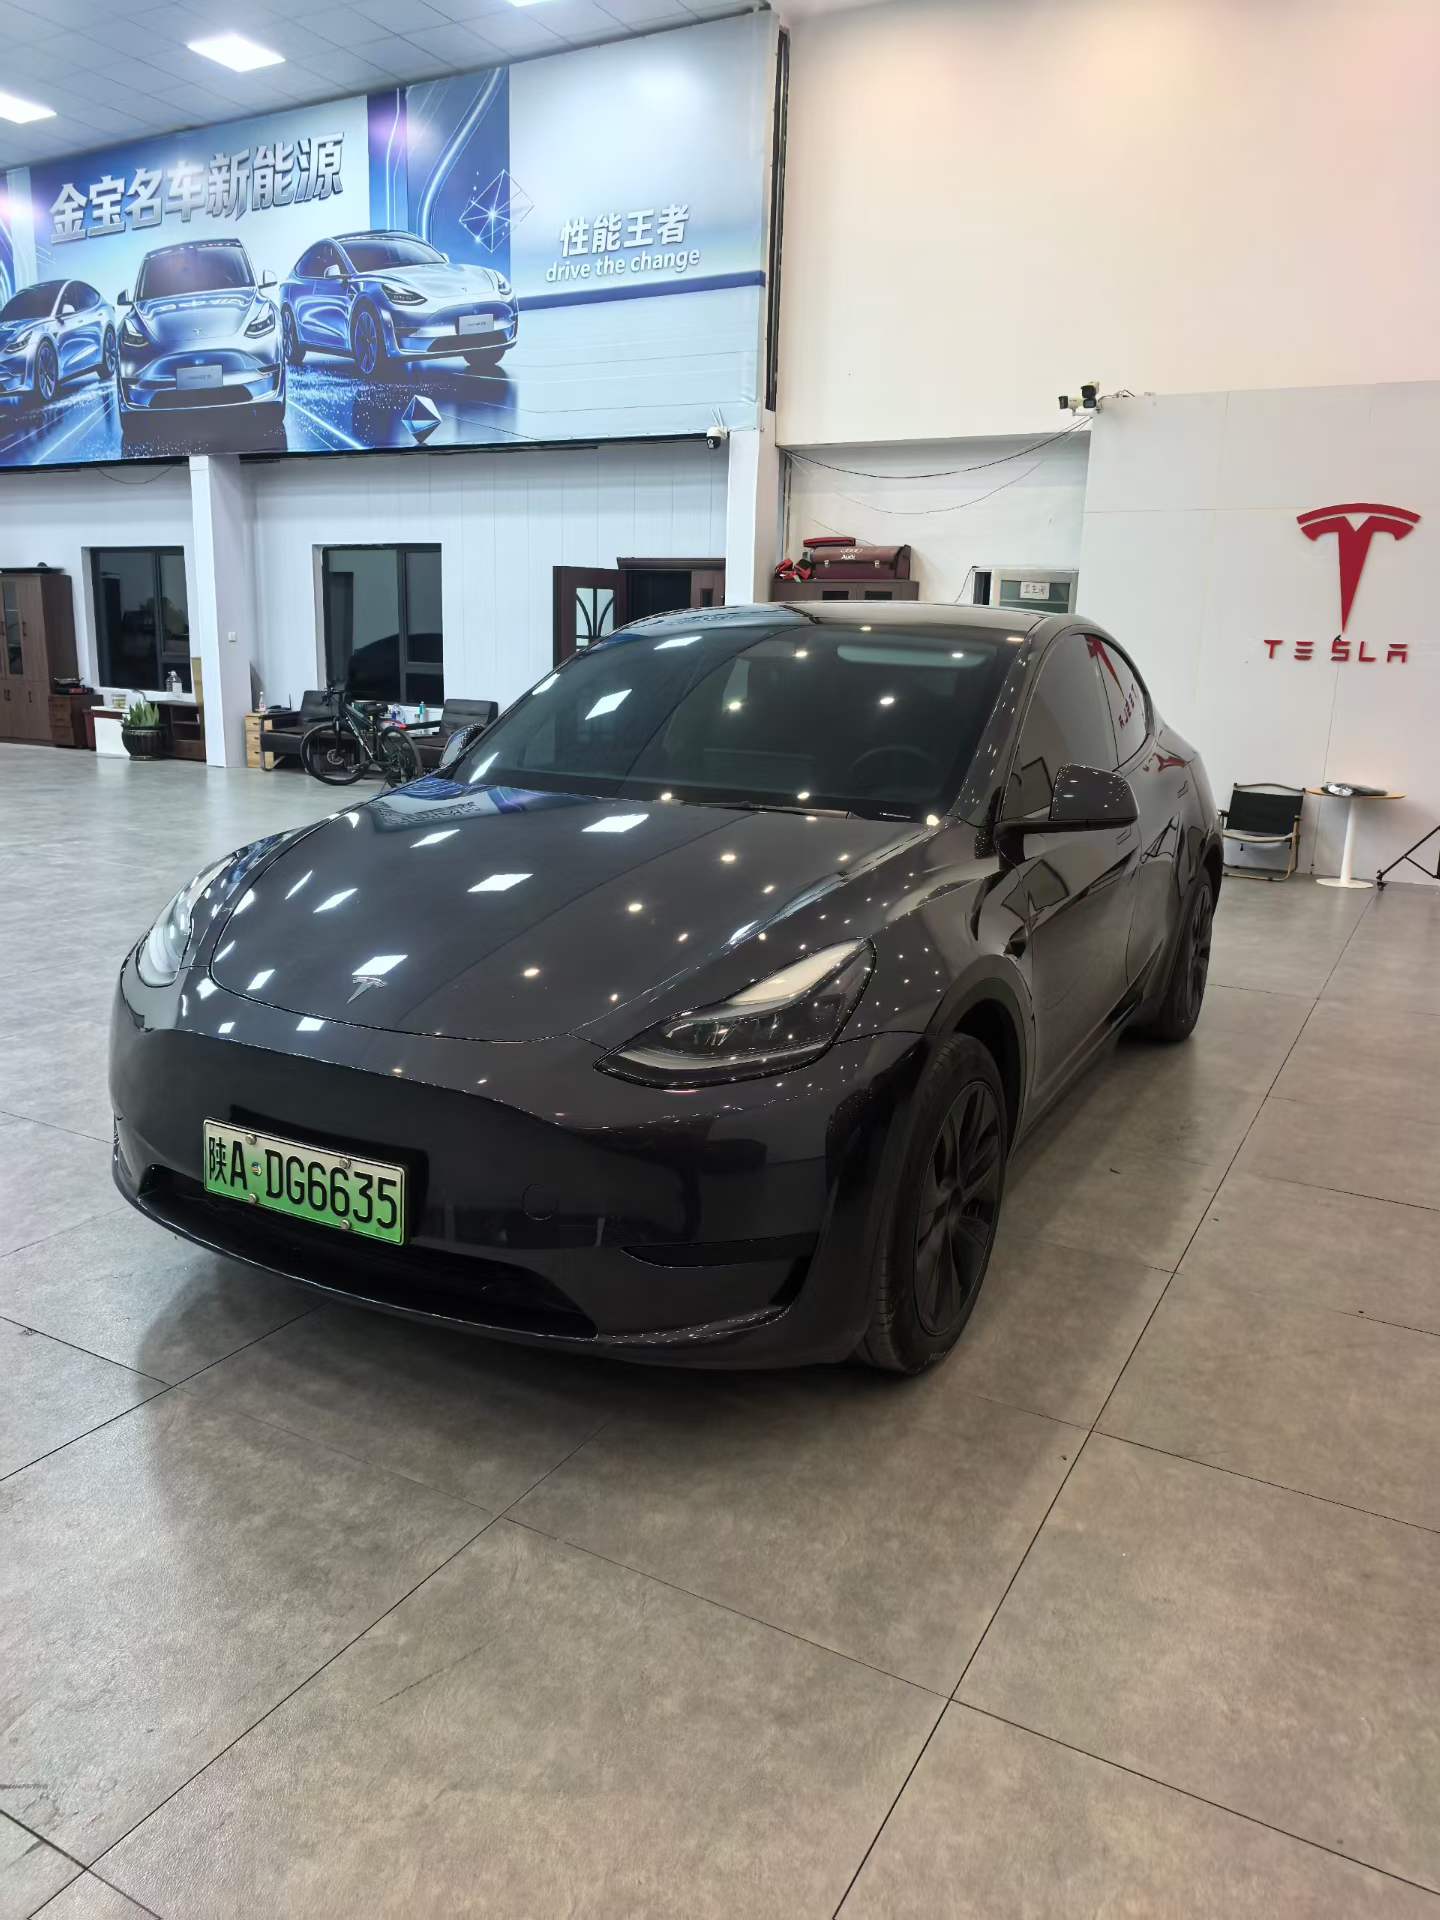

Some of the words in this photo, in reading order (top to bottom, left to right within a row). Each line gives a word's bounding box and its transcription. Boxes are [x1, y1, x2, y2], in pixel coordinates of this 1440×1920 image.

[49, 131, 345, 245] 金宝名车新能源
[559, 204, 690, 258] 性能王者
[545, 260, 591, 282] drive
[596, 255, 625, 275] the
[630, 248, 701, 273] change
[1263, 639, 1409, 664] TESLA
[264, 1148, 398, 1229] DG6635
